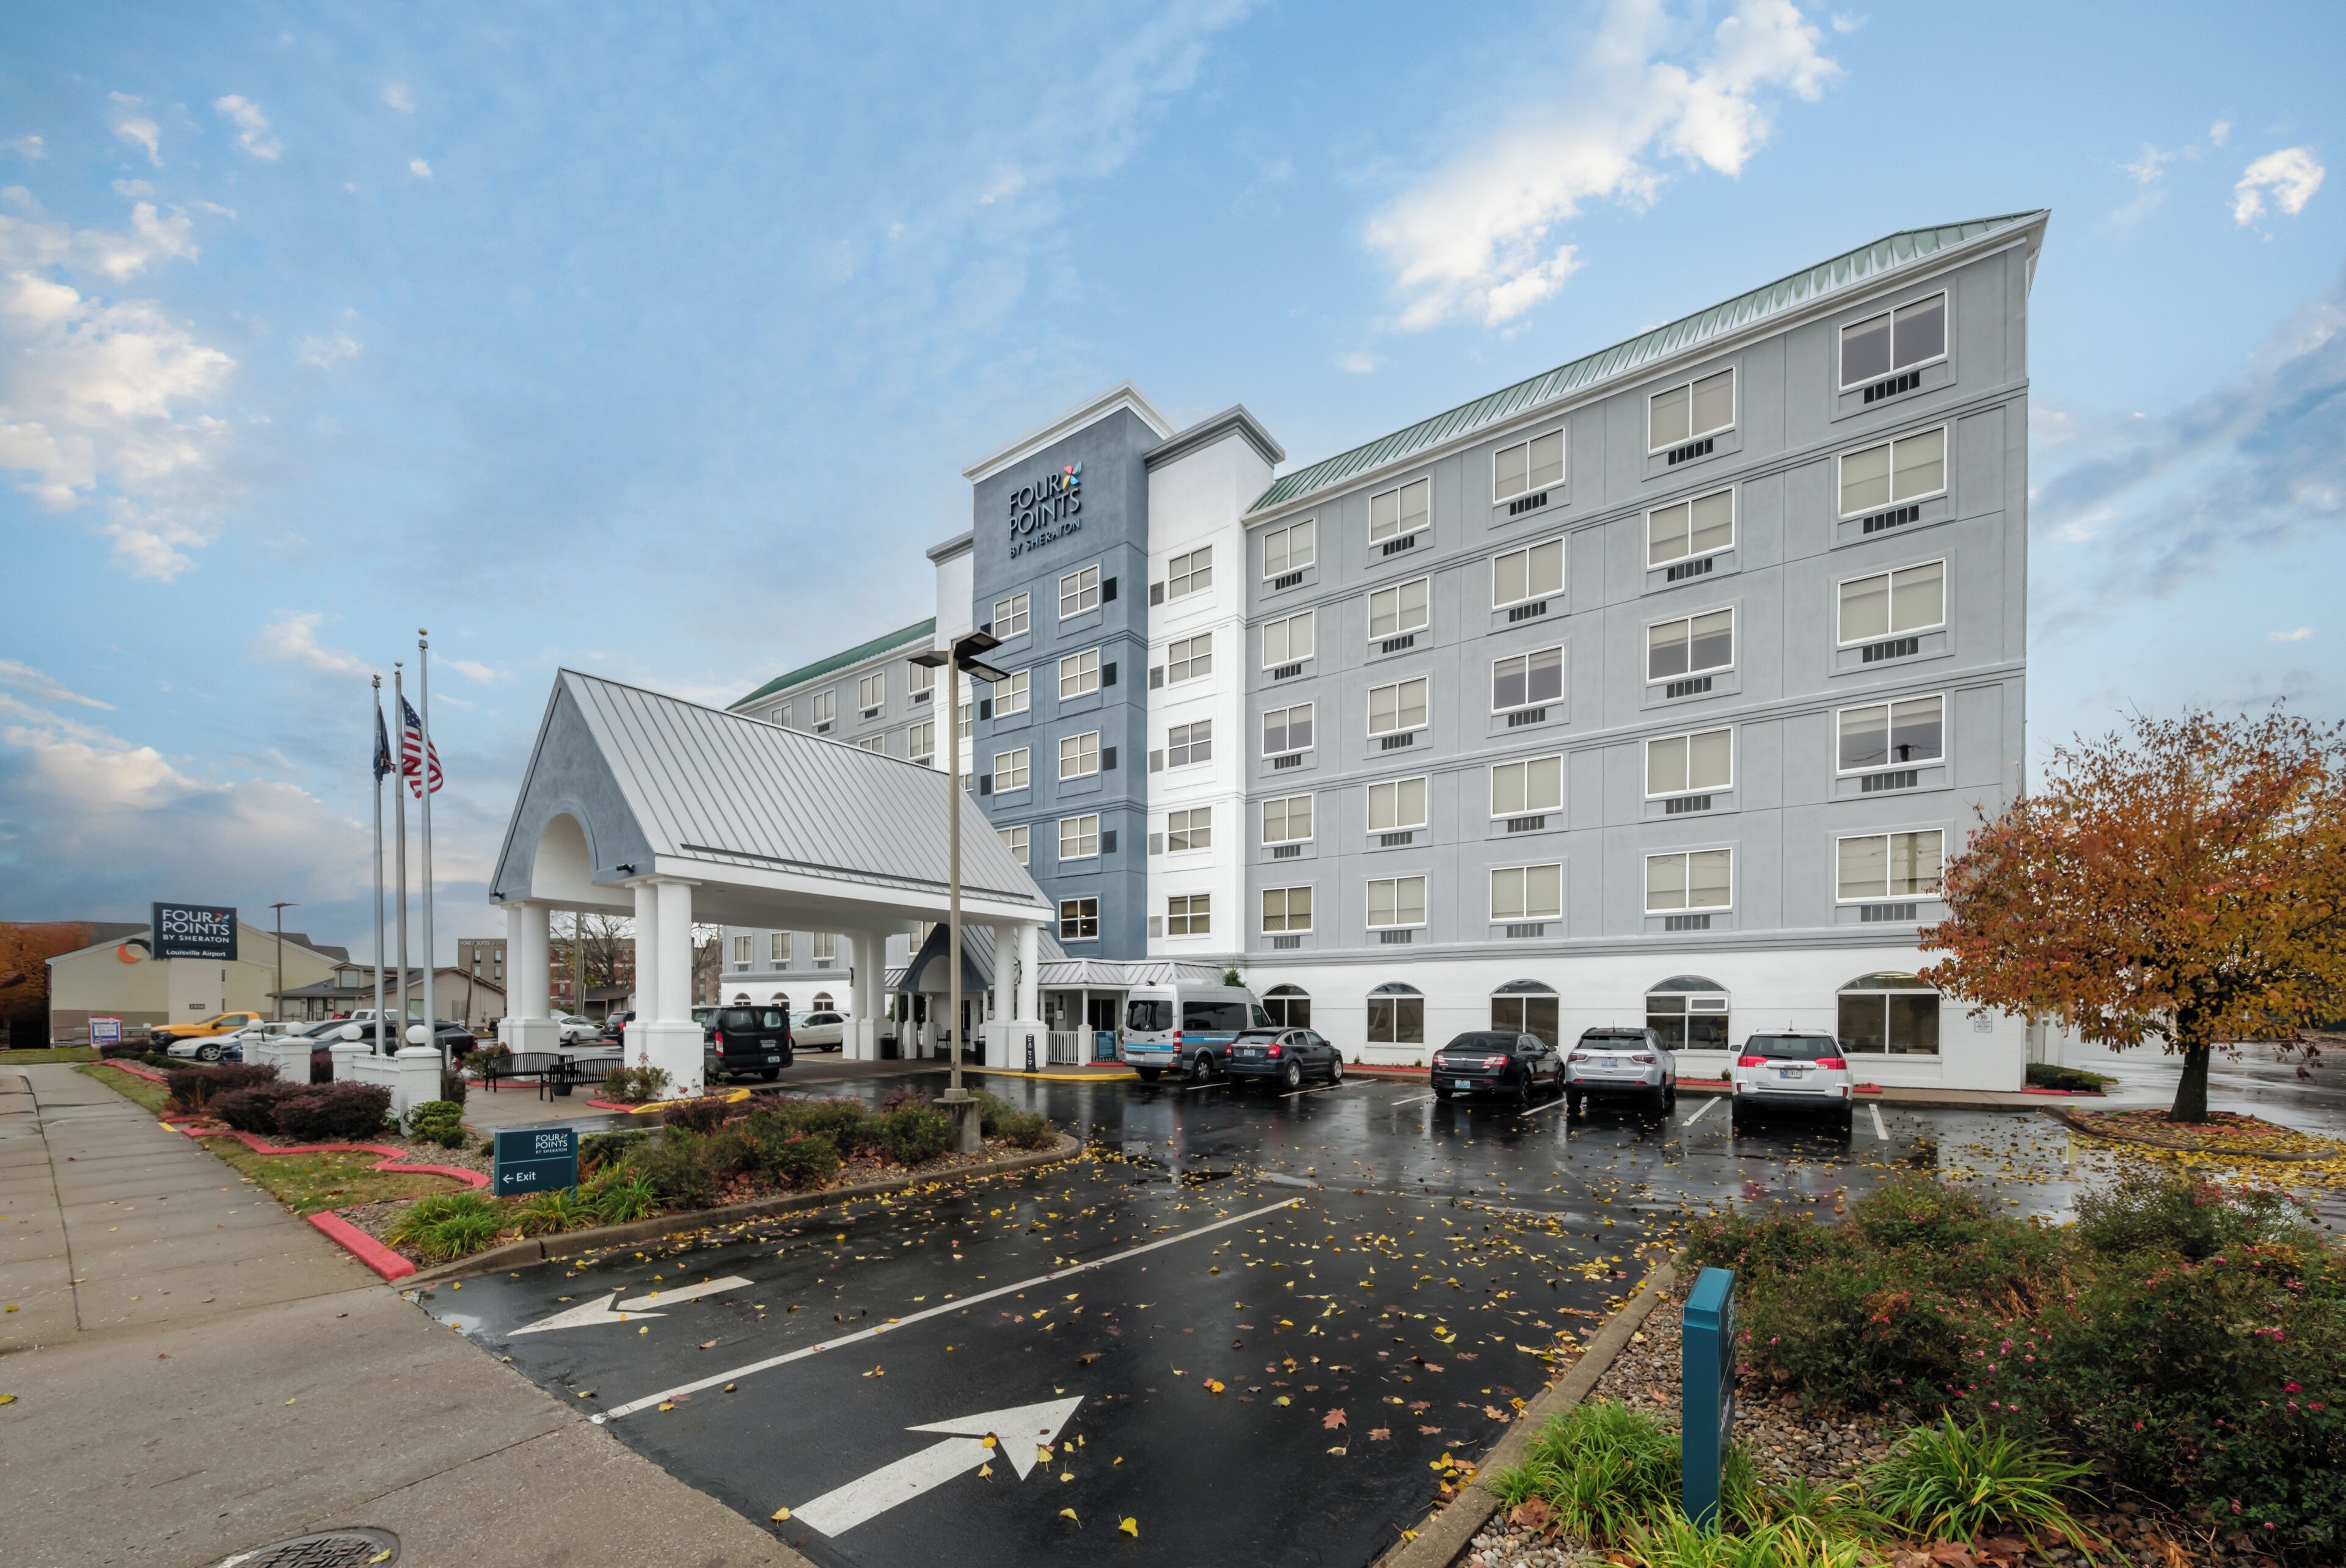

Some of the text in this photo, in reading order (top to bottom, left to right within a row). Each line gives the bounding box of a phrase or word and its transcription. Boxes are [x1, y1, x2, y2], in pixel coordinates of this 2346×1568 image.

[1009, 472, 1061, 516] FOUR
[1009, 487, 1081, 540] POINTS
[1010, 518, 1081, 558] BY SHERATON
[163, 909, 213, 923] FOUR
[163, 921, 230, 935] POINTS
[536, 1134, 560, 1142] FOUR
[536, 1140, 568, 1149] POINTS
[516, 1171, 536, 1181] Exit
